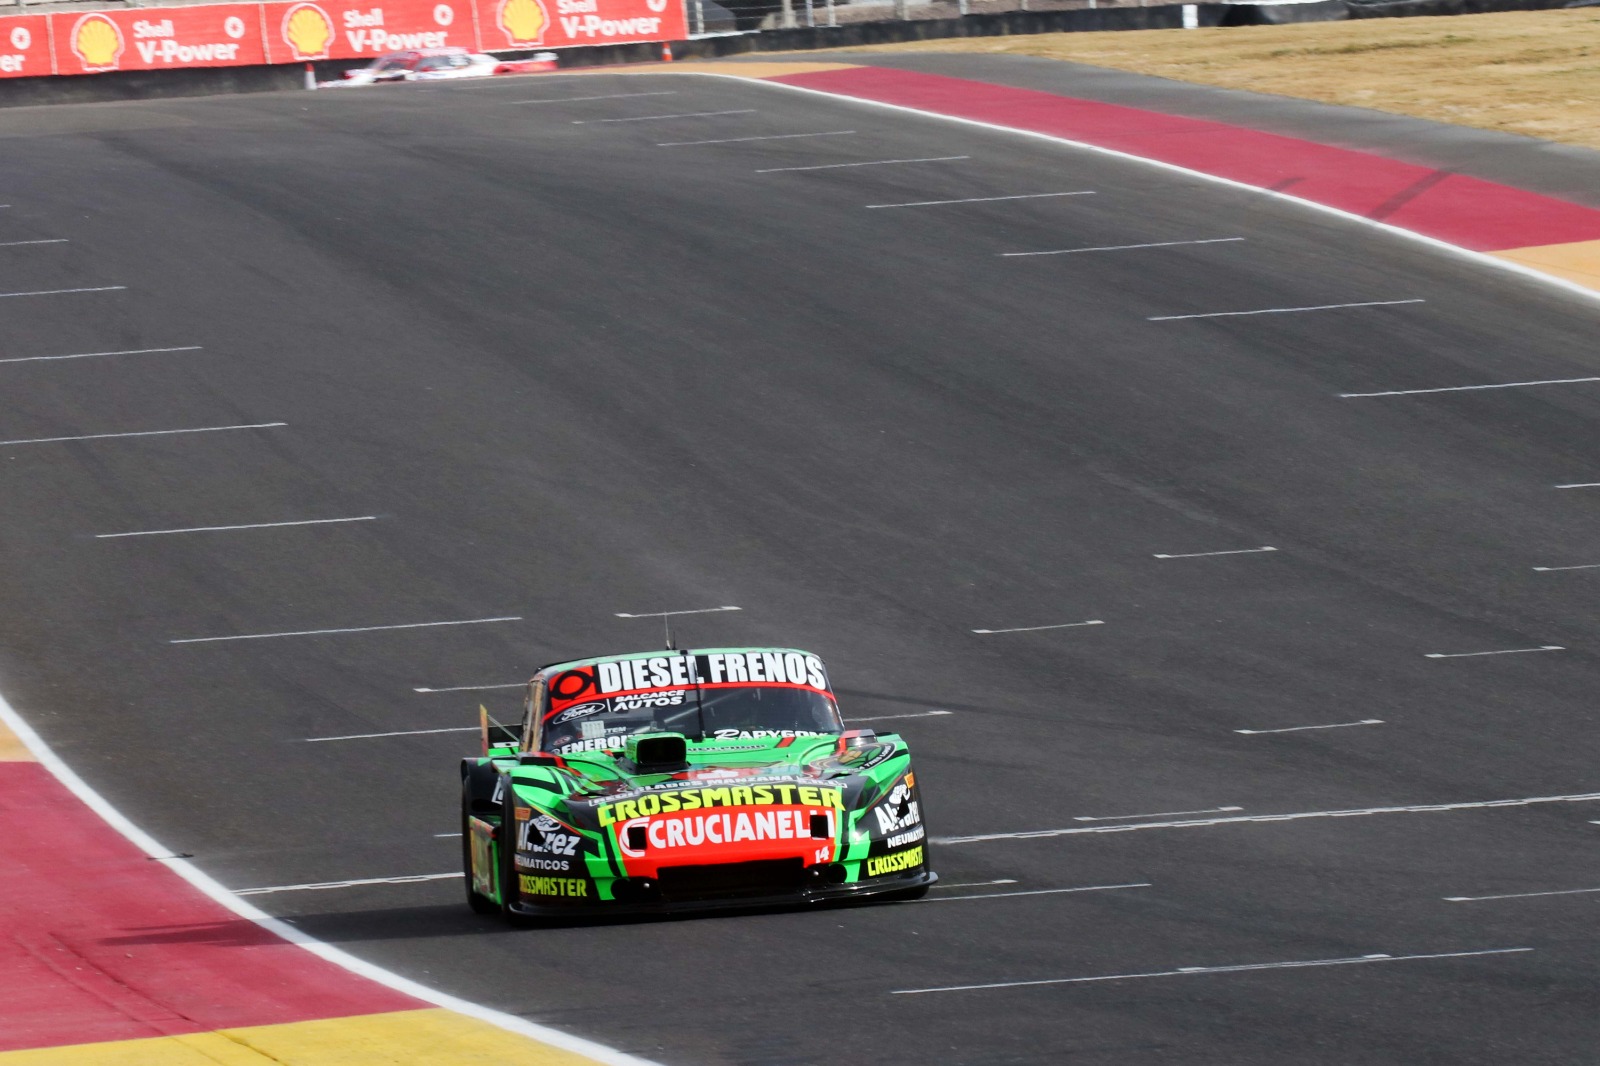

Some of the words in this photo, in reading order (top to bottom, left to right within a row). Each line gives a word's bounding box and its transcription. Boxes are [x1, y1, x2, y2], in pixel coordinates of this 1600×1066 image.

[343, 8, 384, 28] Shell
[560, 14, 662, 38] V-Power
[132, 19, 175, 38] Shell
[345, 29, 448, 52] V-Power
[135, 40, 240, 64] V-Power
[598, 655, 705, 693] DIESEL
[708, 652, 827, 691] FRENOS
[613, 697, 683, 712] AUTOS
[615, 689, 686, 703] BALCARCE
[561, 704, 597, 721] Ford
[597, 784, 846, 828] CROSSMASTER
[815, 845, 830, 864] 14
